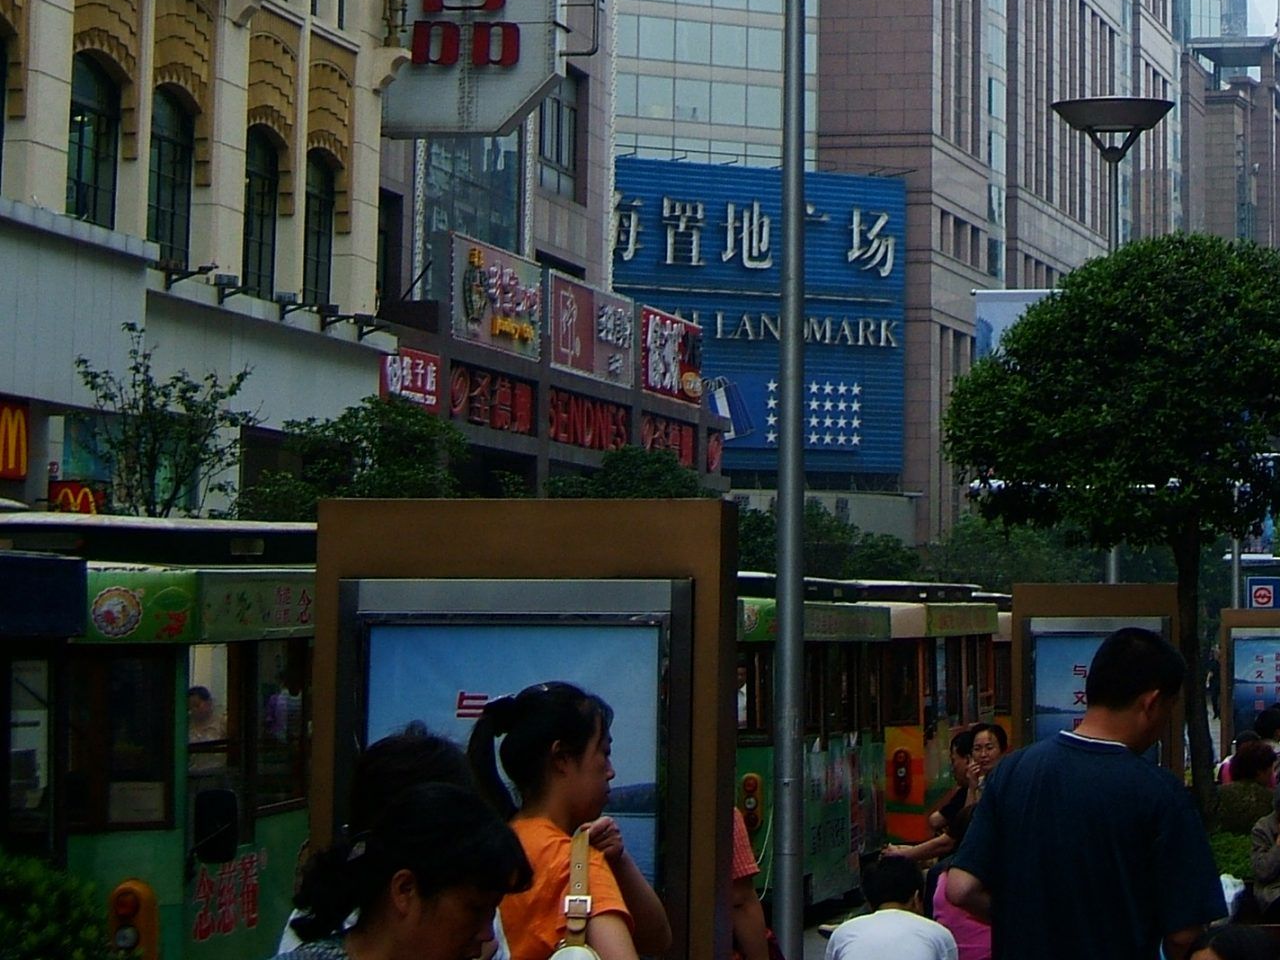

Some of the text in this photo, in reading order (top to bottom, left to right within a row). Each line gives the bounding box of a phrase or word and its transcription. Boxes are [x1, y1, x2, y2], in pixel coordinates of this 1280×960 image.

[613, 191, 897, 278] 海置地场
[714, 310, 899, 348] LANMARK
